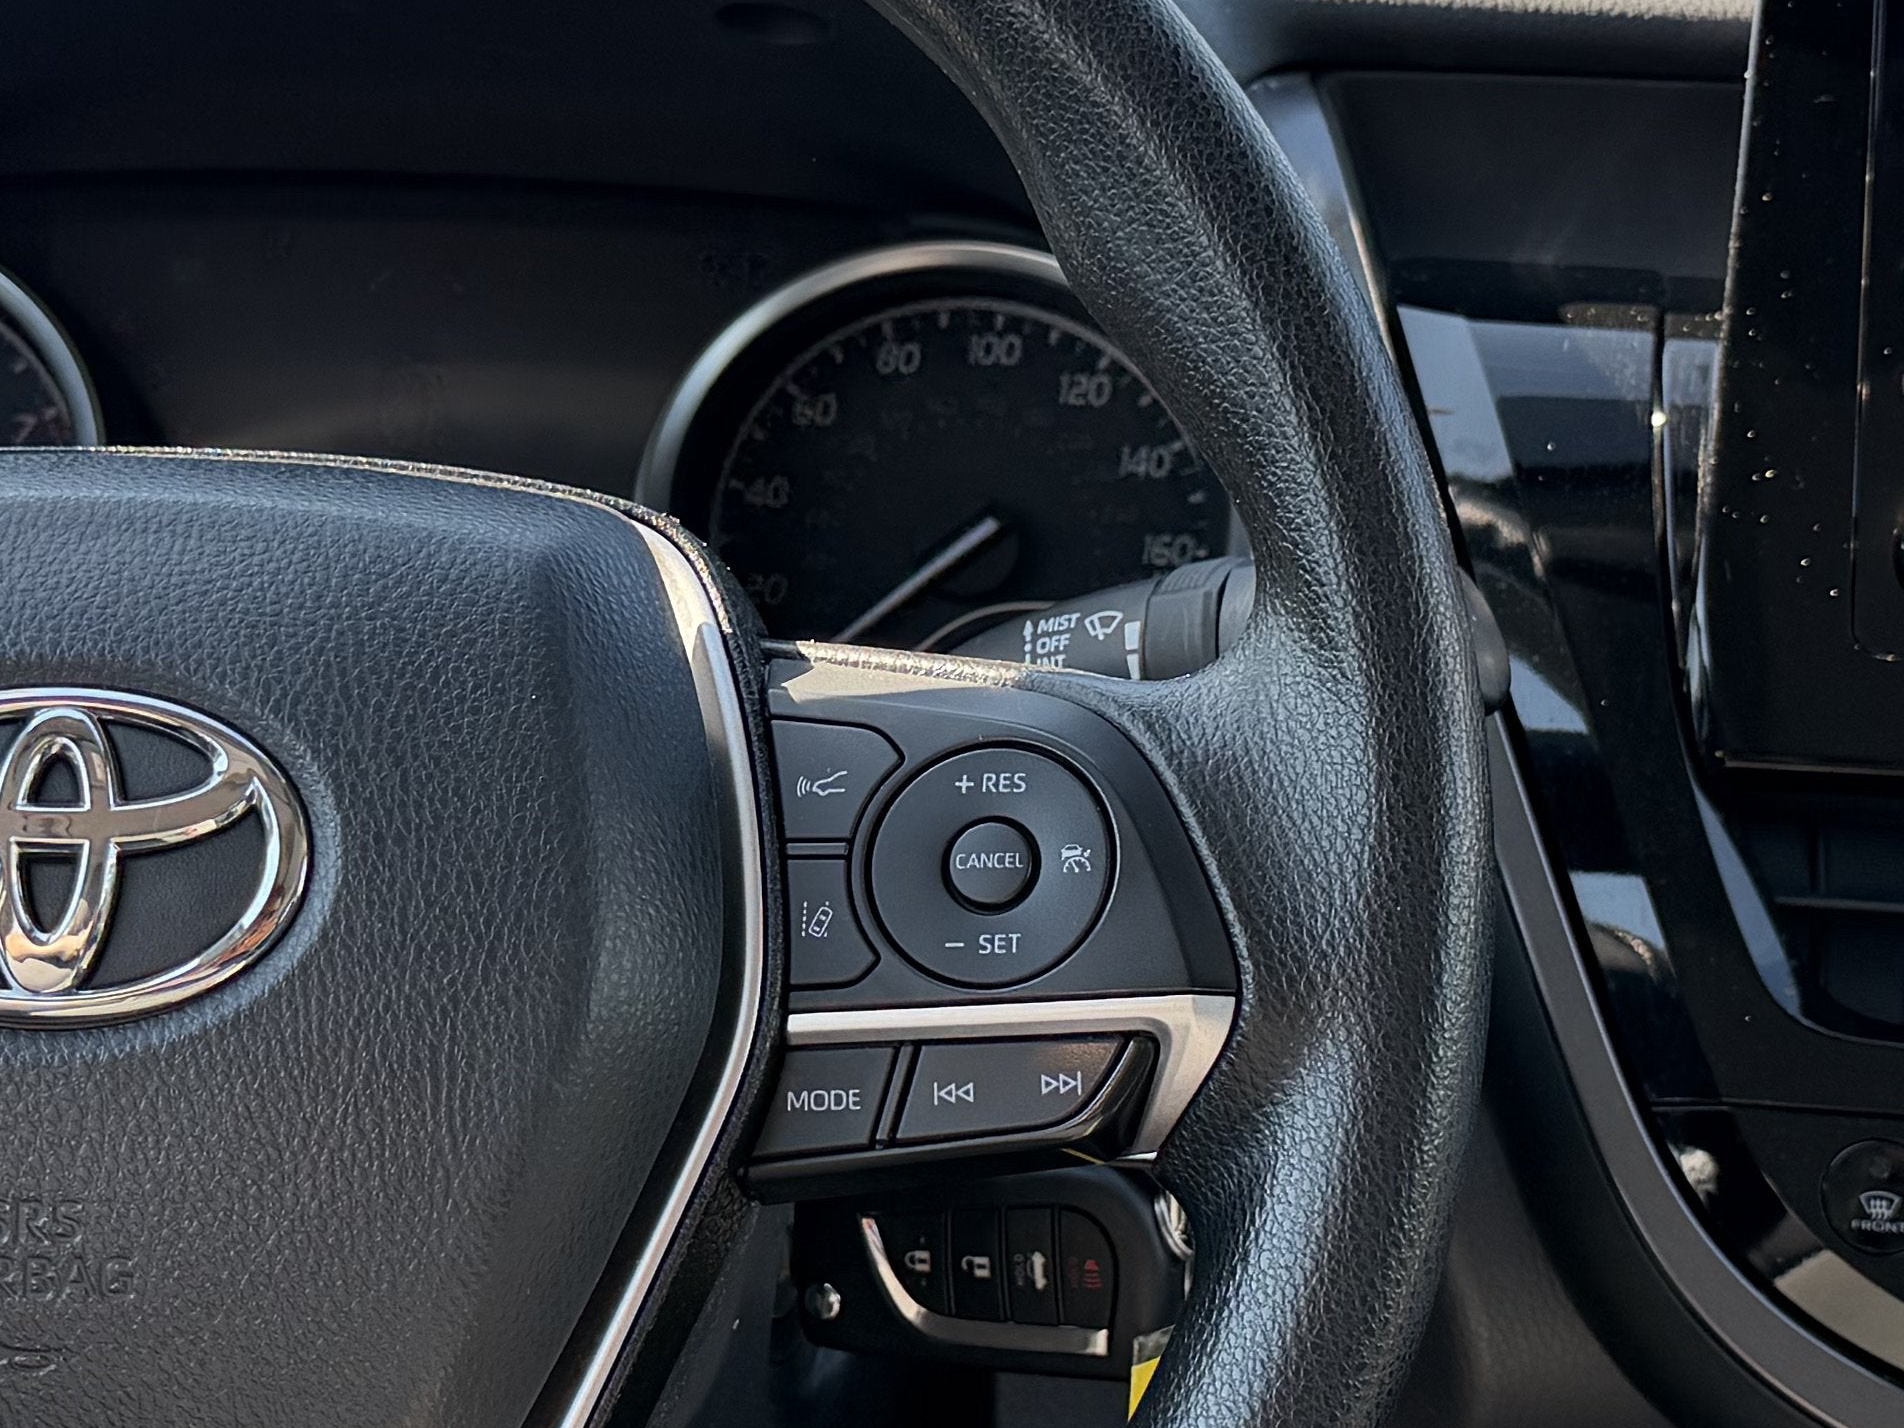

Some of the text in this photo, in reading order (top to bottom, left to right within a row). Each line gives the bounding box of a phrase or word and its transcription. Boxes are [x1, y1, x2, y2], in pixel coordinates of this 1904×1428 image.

[876, 339, 922, 374] 80
[966, 334, 1024, 366] 100
[1058, 372, 1113, 407] 120
[1117, 444, 1173, 479] 140
[744, 475, 790, 509] 40
[1142, 533, 1197, 567] 160
[1037, 612, 1081, 634] MIST
[1036, 633, 1071, 654] OFF
[982, 772, 1026, 793] RES
[955, 852, 1024, 870] CANCEL
[978, 933, 1021, 955] SET
[786, 1089, 861, 1112] MODE
